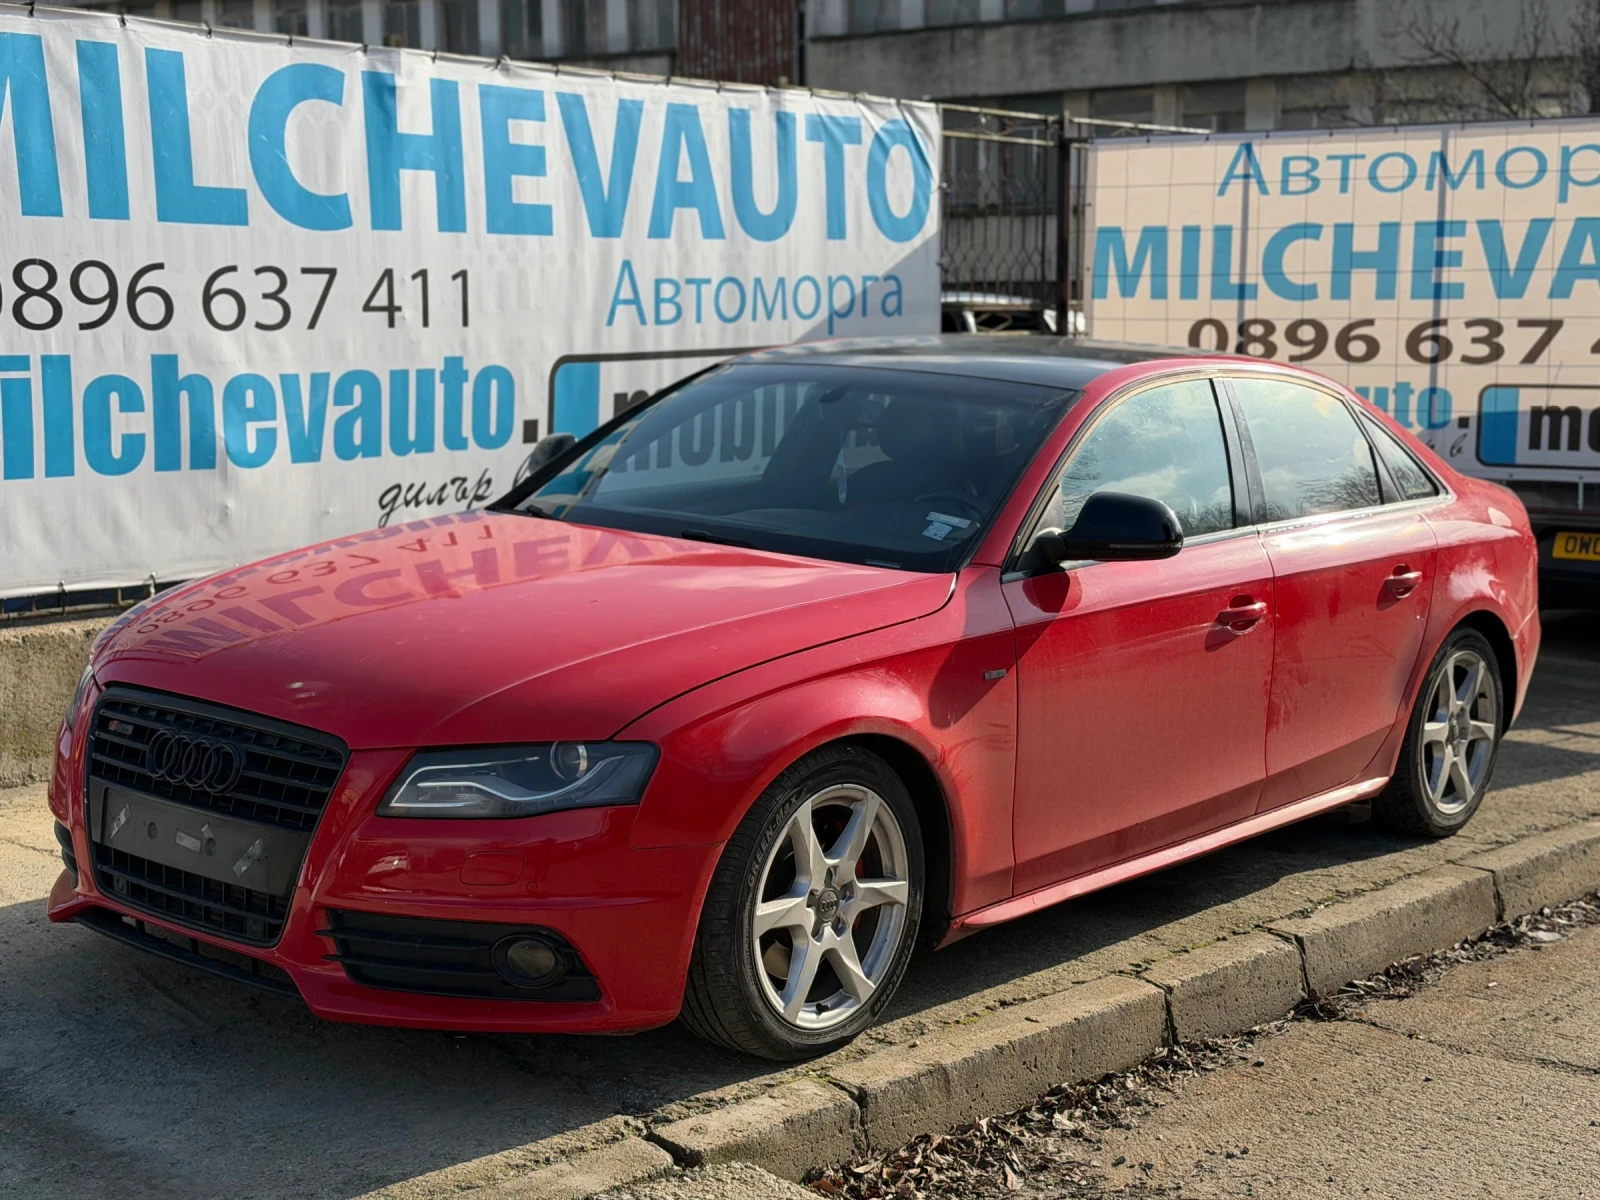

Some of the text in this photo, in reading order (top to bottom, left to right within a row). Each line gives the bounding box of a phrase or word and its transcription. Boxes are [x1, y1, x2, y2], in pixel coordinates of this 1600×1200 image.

[1217, 142, 1600, 204] Автомор
[0, 258, 469, 331] 896 637 411
[1091, 217, 1600, 300] MILCHEVA
[606, 259, 903, 335] Автоморга
[1188, 318, 1564, 364] 0896 637
